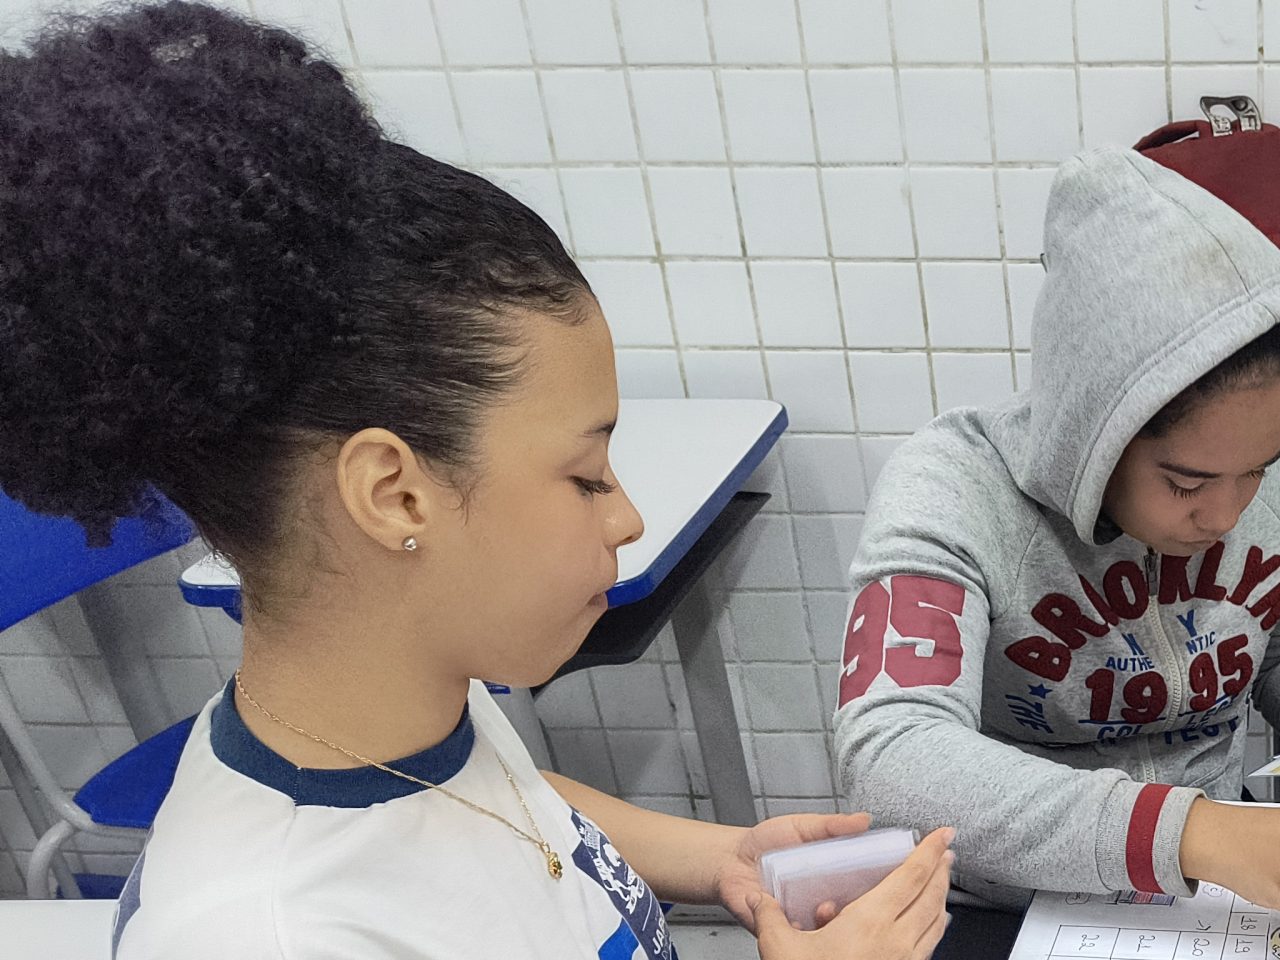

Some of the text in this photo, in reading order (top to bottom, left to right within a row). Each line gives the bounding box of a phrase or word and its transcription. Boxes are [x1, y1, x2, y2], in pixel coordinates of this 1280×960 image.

[838, 574, 966, 710] 95
[1241, 915, 1258, 931] 18
[1078, 933, 1100, 951] 22
[1136, 934, 1156, 953] 21
[1192, 937, 1210, 956] 20
[1235, 938, 1254, 954] 19
